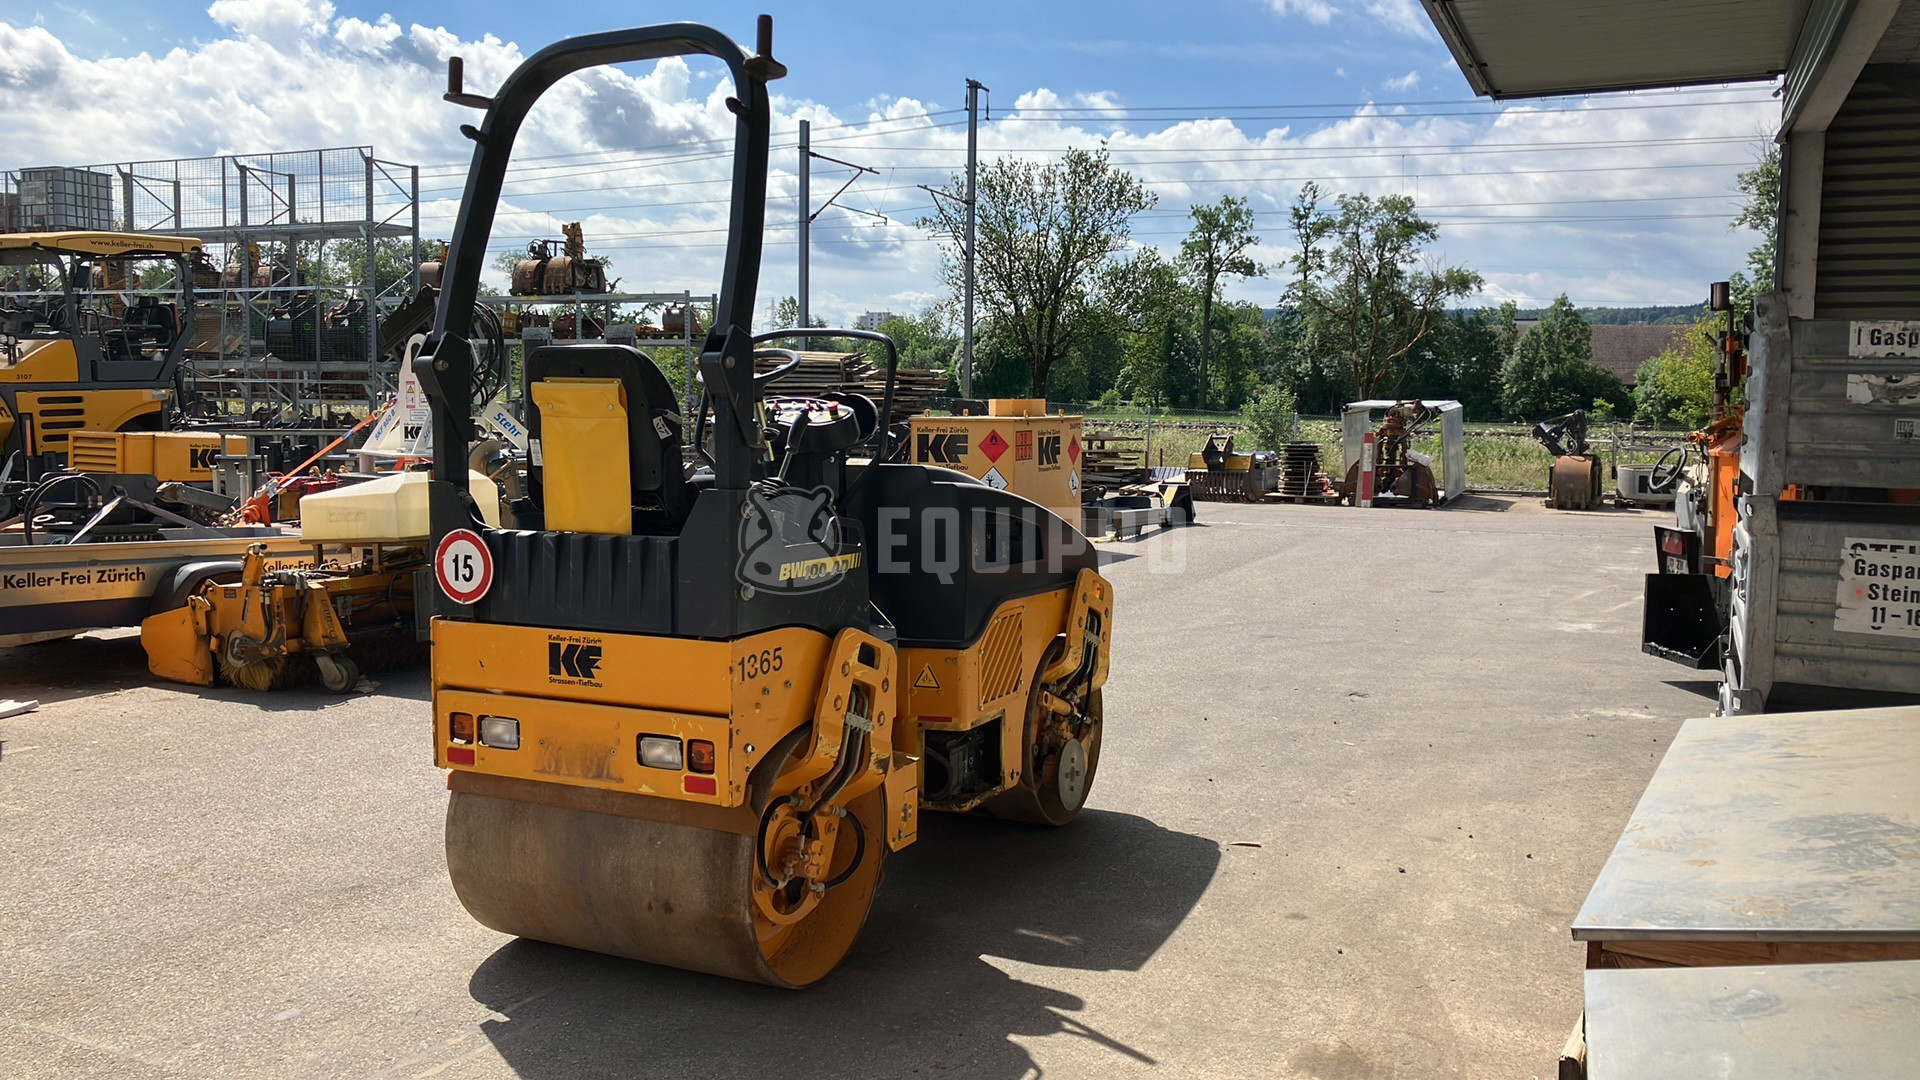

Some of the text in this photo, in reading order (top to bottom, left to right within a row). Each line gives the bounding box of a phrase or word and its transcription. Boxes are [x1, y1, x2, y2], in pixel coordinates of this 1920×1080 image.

[90, 240, 154, 249] www.keller-frei.ch
[494, 412, 522, 438] Stehr
[263, 560, 316, 573] Keller-Fre
[453, 554, 474, 582] 15
[3, 567, 146, 589] Keller-Frei Zürich
[548, 634, 581, 643] Keller-Frei
[738, 647, 783, 681] 1365
